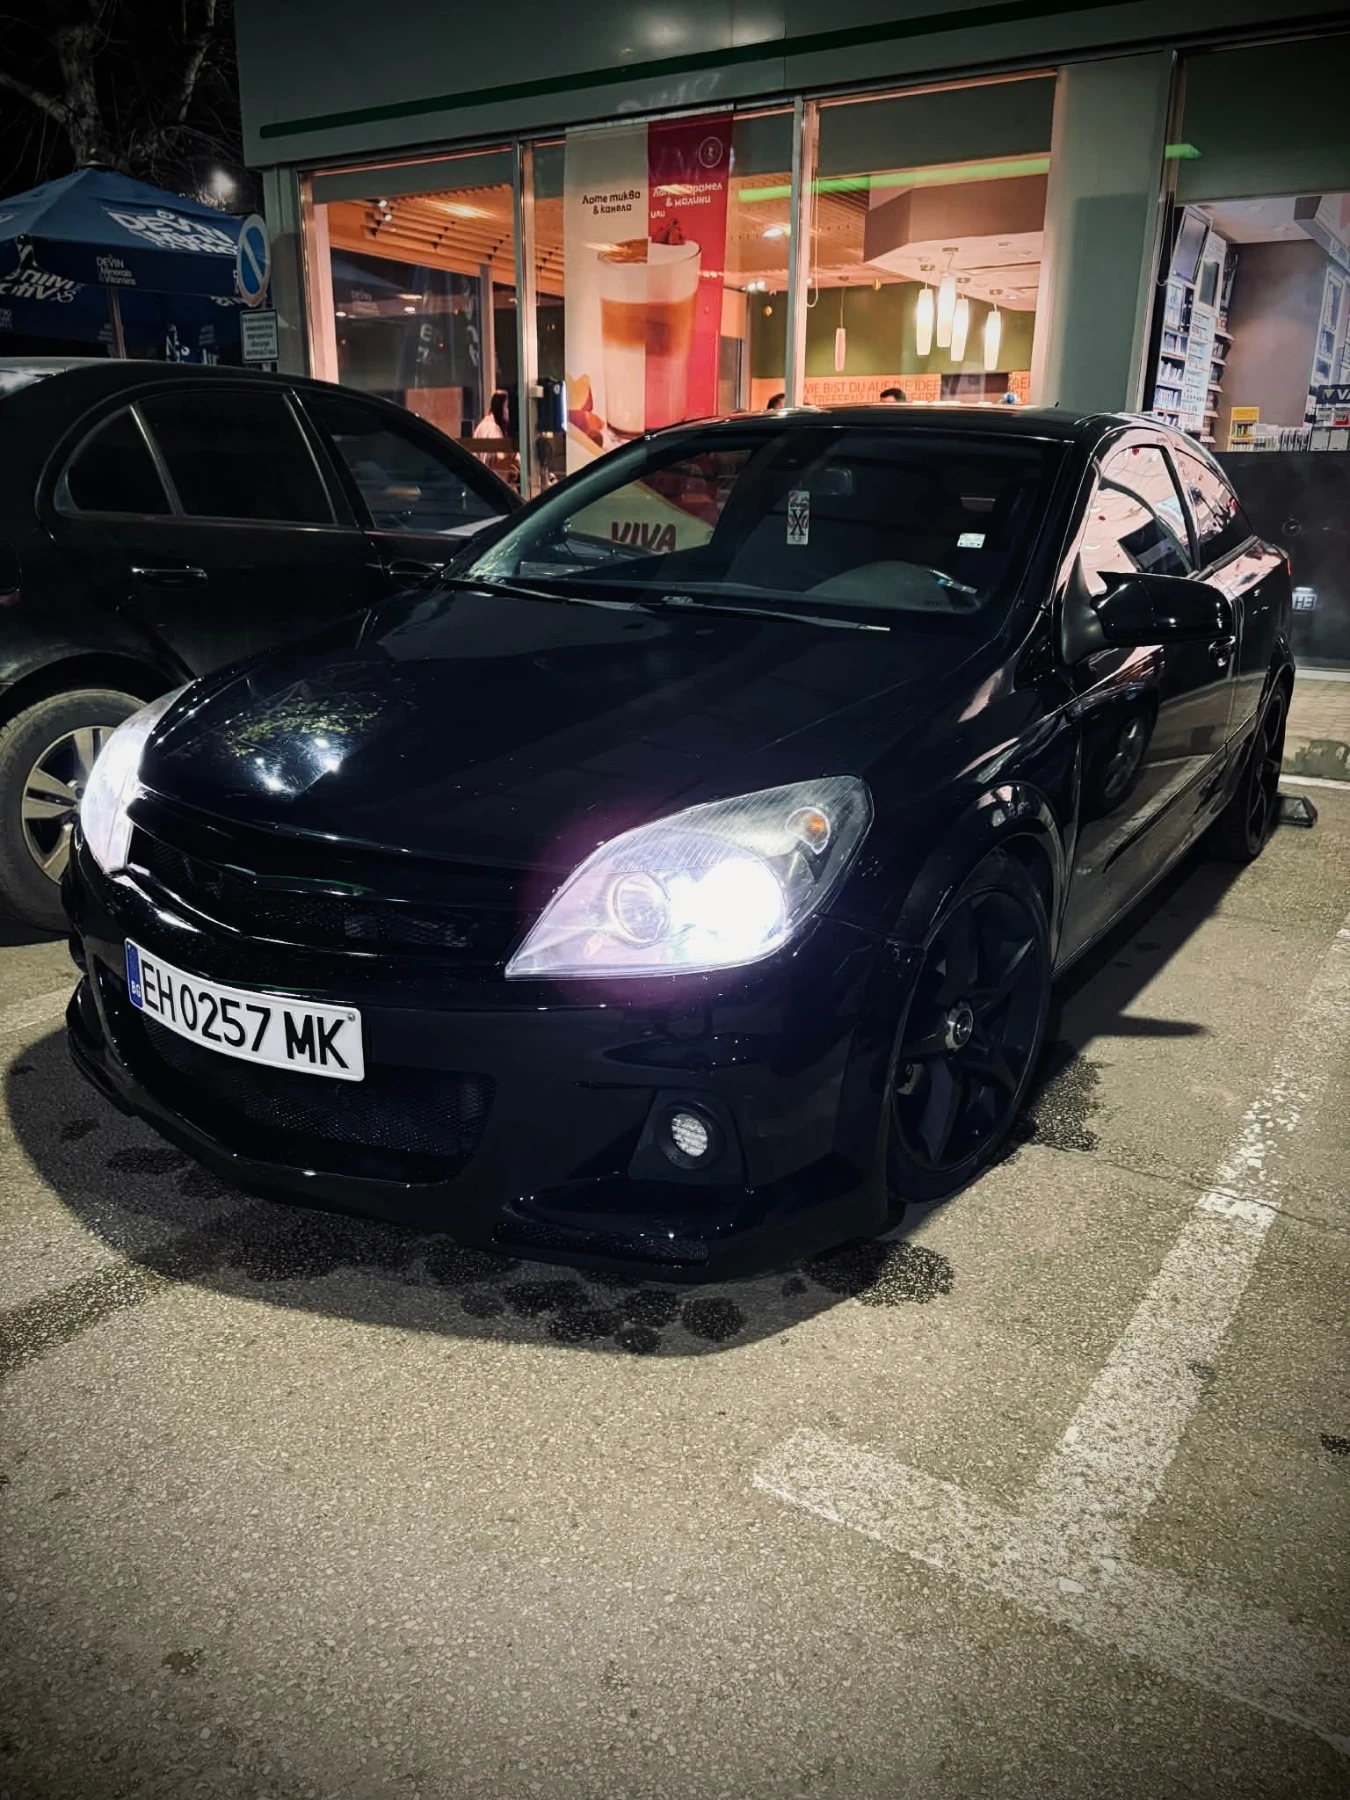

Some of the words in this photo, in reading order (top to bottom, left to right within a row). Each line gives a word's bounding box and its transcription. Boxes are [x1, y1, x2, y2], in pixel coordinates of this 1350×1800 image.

[610, 189, 641, 203] тиква
[674, 195, 711, 207] малини
[601, 203, 632, 214] канела
[823, 381, 845, 394] BIST
[849, 381, 866, 393] DU
[611, 520, 677, 552] VIVA
[131, 979, 142, 997] BG
[140, 958, 177, 1023] EH
[179, 983, 272, 1053] 0257
[283, 1010, 350, 1070] MK
